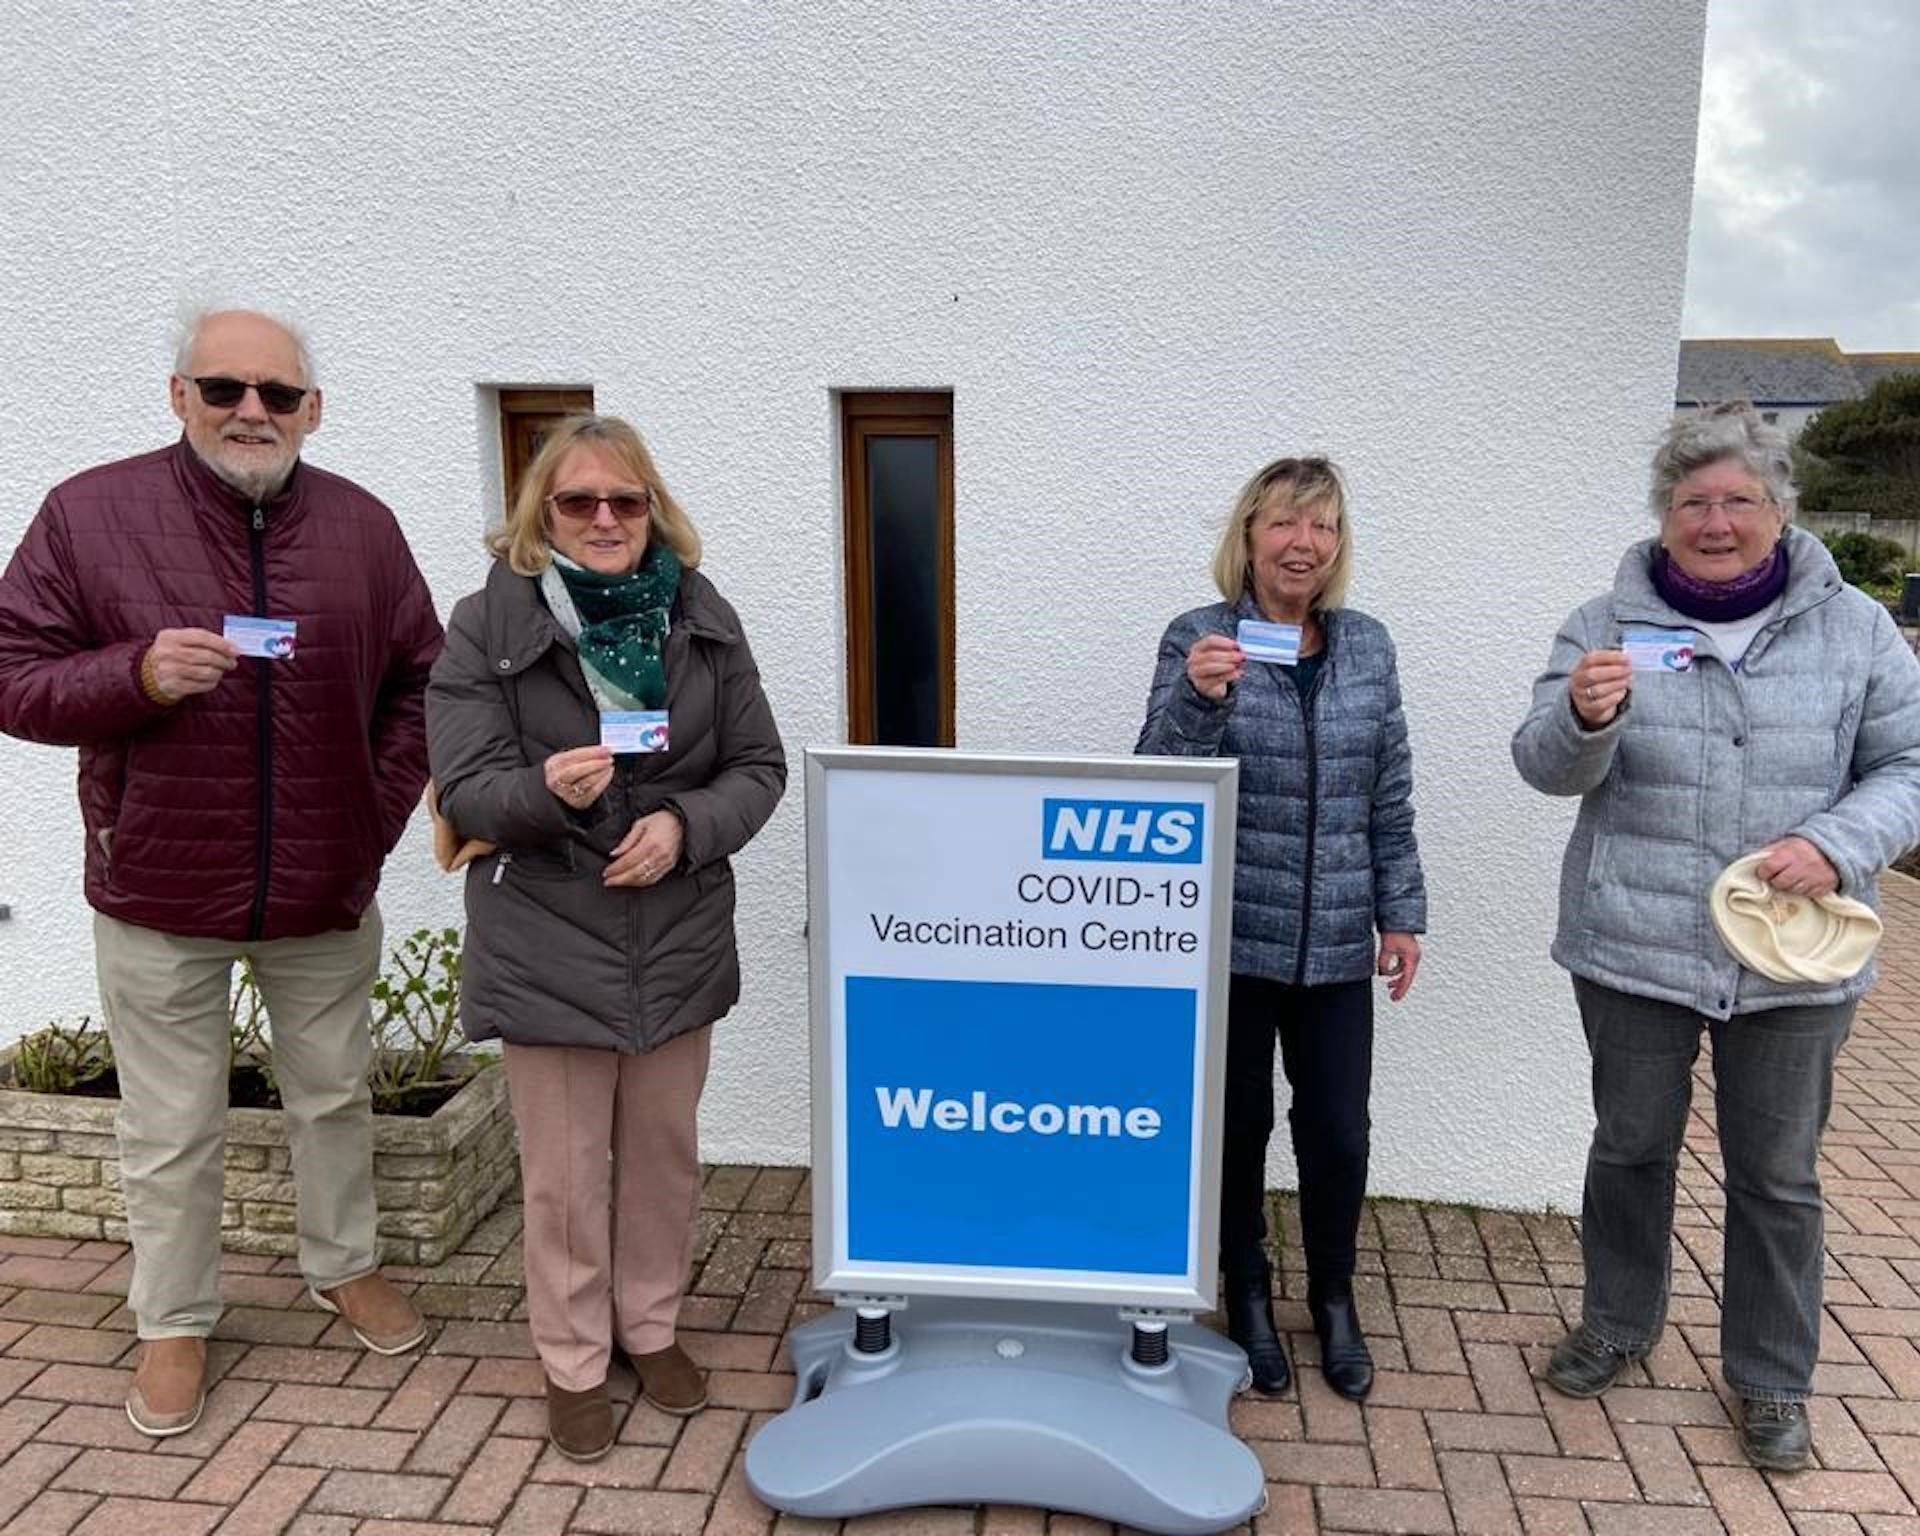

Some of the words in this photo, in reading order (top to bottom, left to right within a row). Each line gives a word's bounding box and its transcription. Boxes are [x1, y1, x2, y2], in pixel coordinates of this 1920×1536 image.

[1050, 807, 1195, 854] NHS
[1017, 873, 1200, 909] COVID-19
[870, 913, 1067, 949] Vaccination
[1080, 920, 1199, 954] Centre
[875, 1087, 1161, 1138] Welcome
